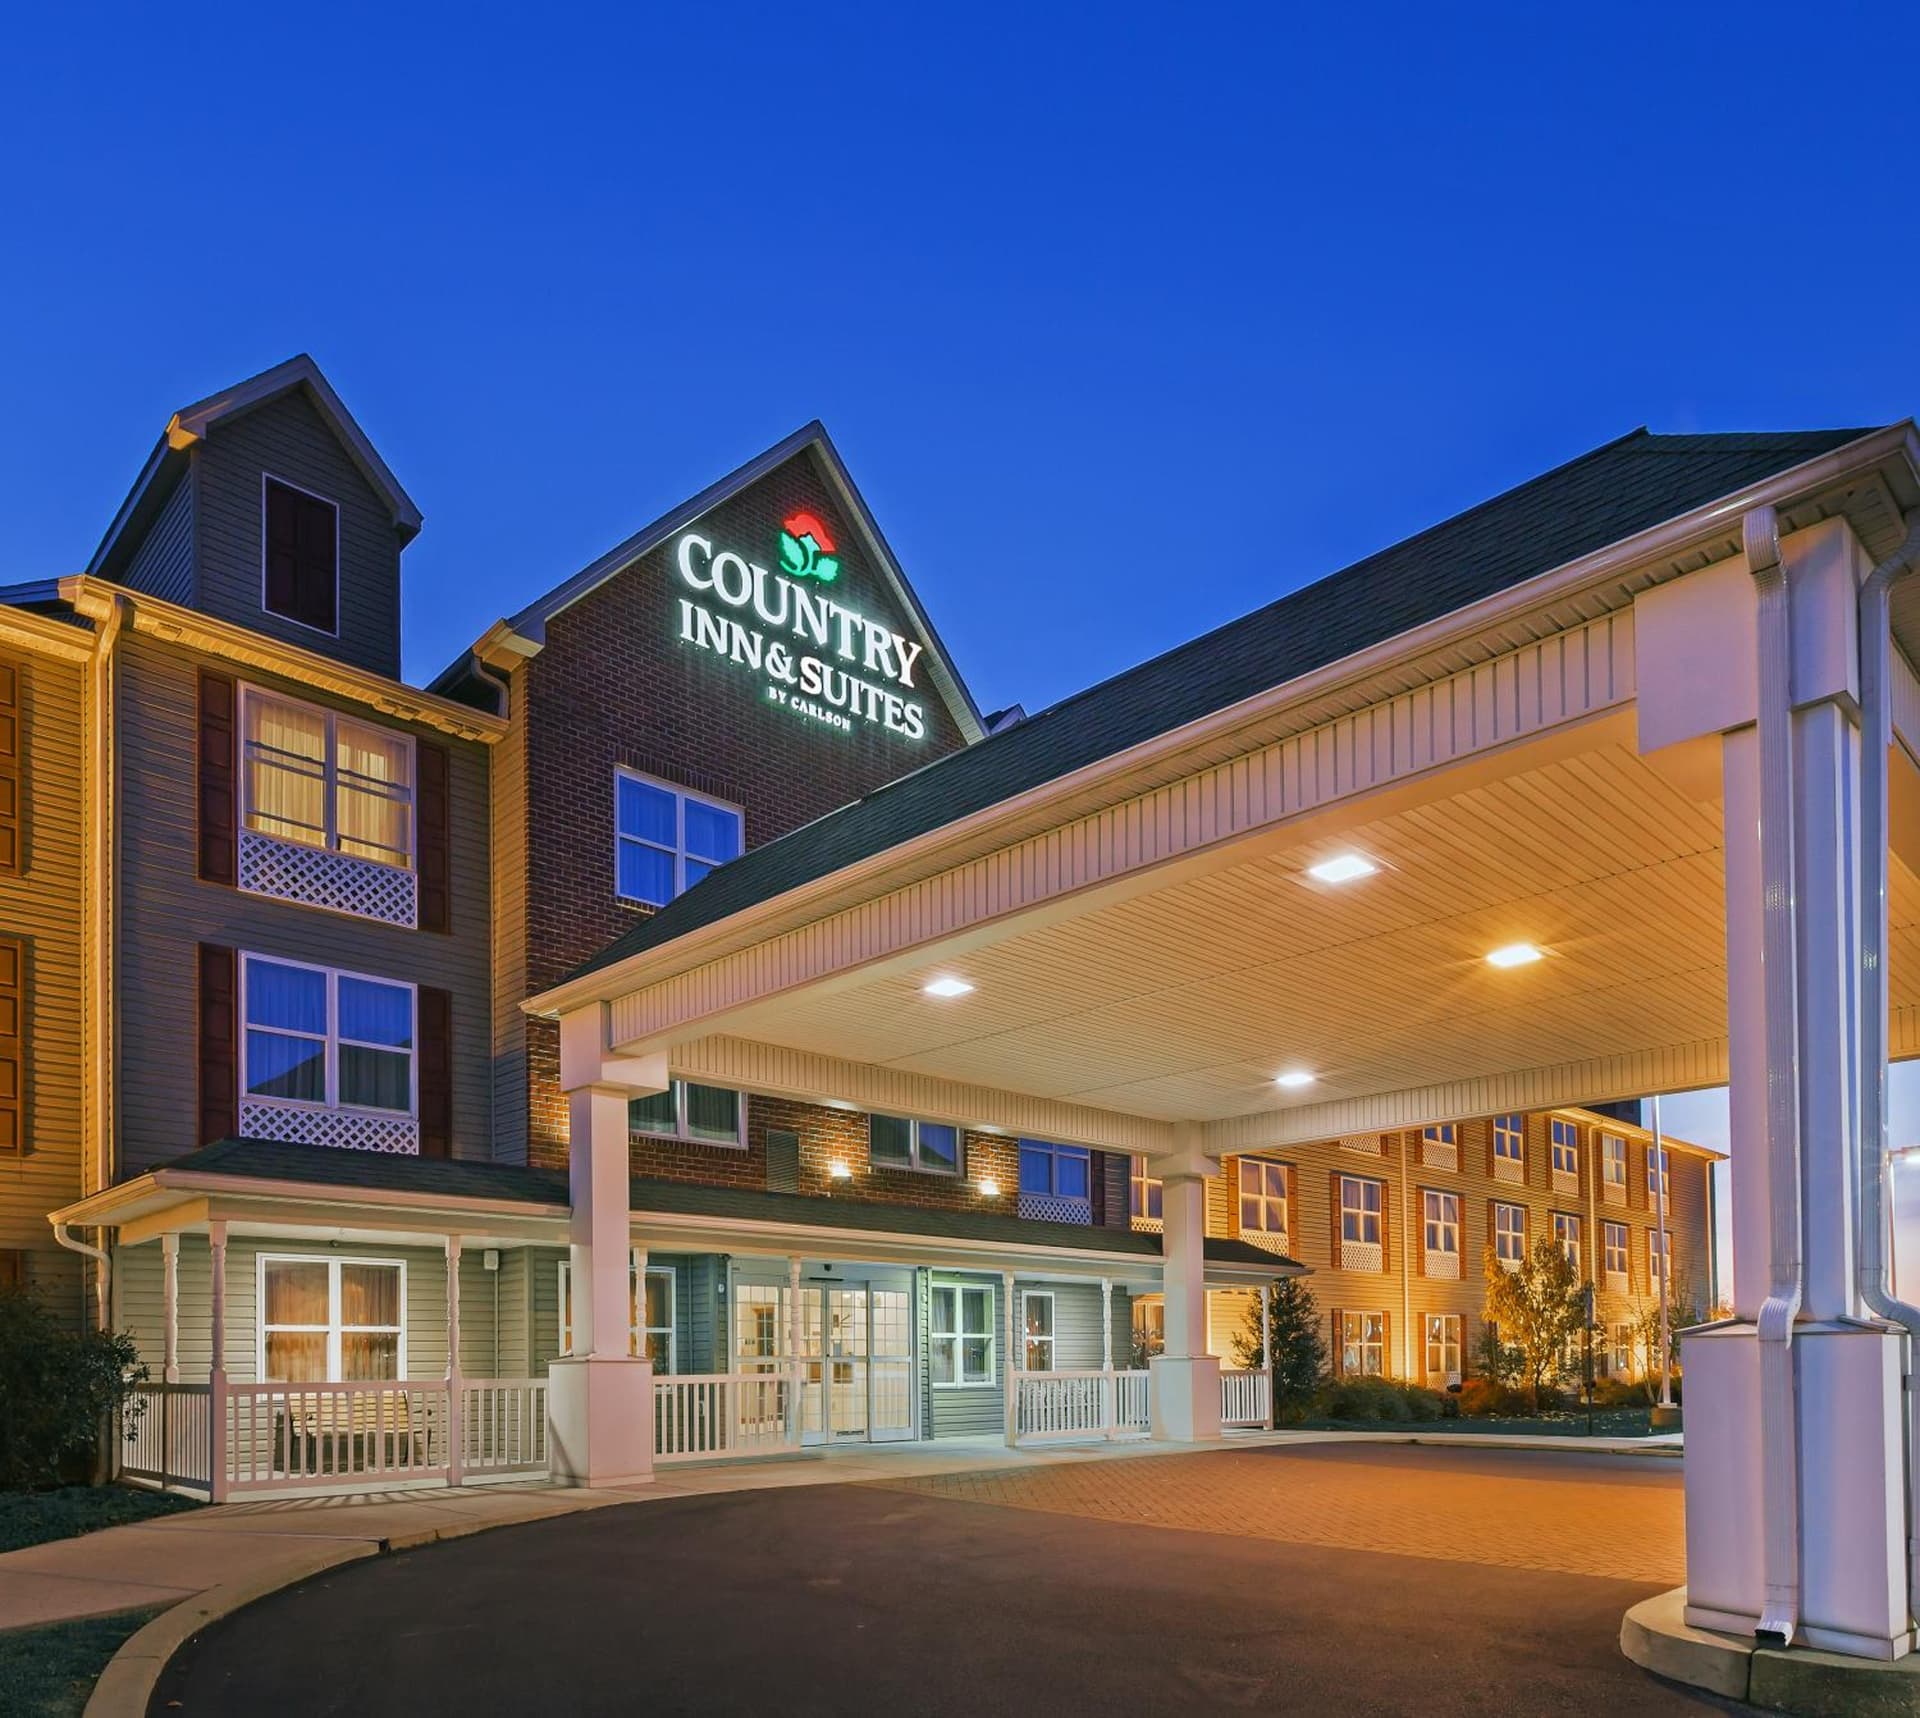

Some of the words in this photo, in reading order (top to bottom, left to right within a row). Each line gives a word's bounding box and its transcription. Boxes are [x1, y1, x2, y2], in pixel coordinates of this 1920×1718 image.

[678, 534, 923, 688] COUNTRY
[768, 686, 787, 704] BY
[791, 697, 850, 732] CARLSON
